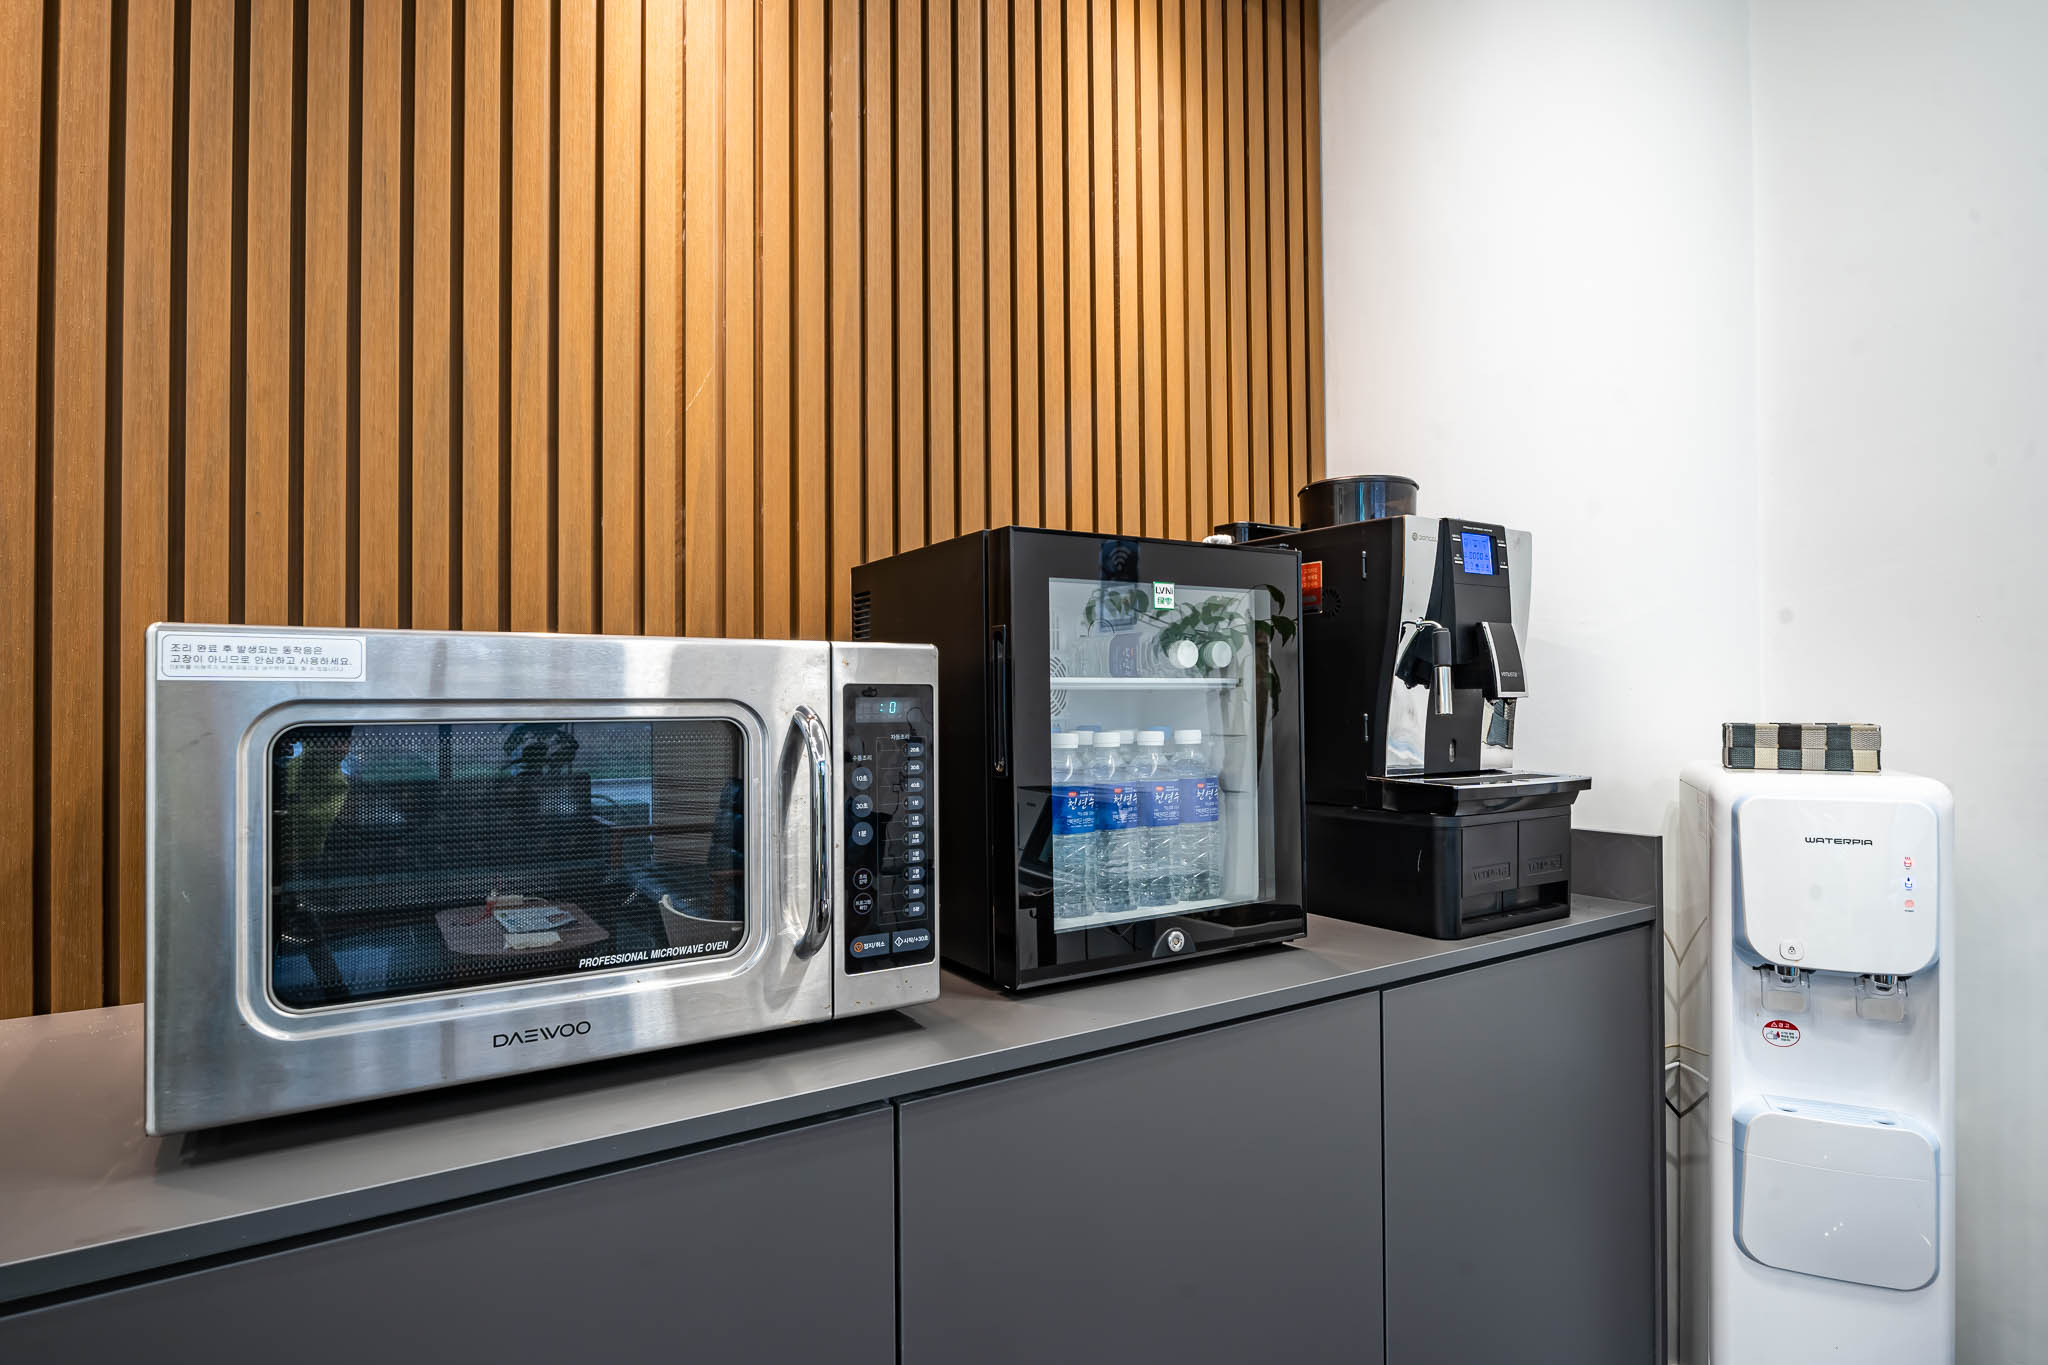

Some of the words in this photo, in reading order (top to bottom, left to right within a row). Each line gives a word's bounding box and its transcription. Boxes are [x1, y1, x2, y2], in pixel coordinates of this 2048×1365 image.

[170, 643, 192, 653] 조리
[236, 645, 279, 655] 발생되는
[282, 646, 323, 655] 동작음은
[170, 654, 203, 664] 고장이
[208, 655, 250, 664] 아니므로
[254, 656, 295, 665] 안심하고
[1804, 836, 1873, 846] WATERPIA
[578, 951, 649, 969] PROFESSIONAL
[650, 943, 704, 959] MICROWAVE
[705, 940, 729, 952] OVEN
[493, 1020, 591, 1048] DAEWOO
